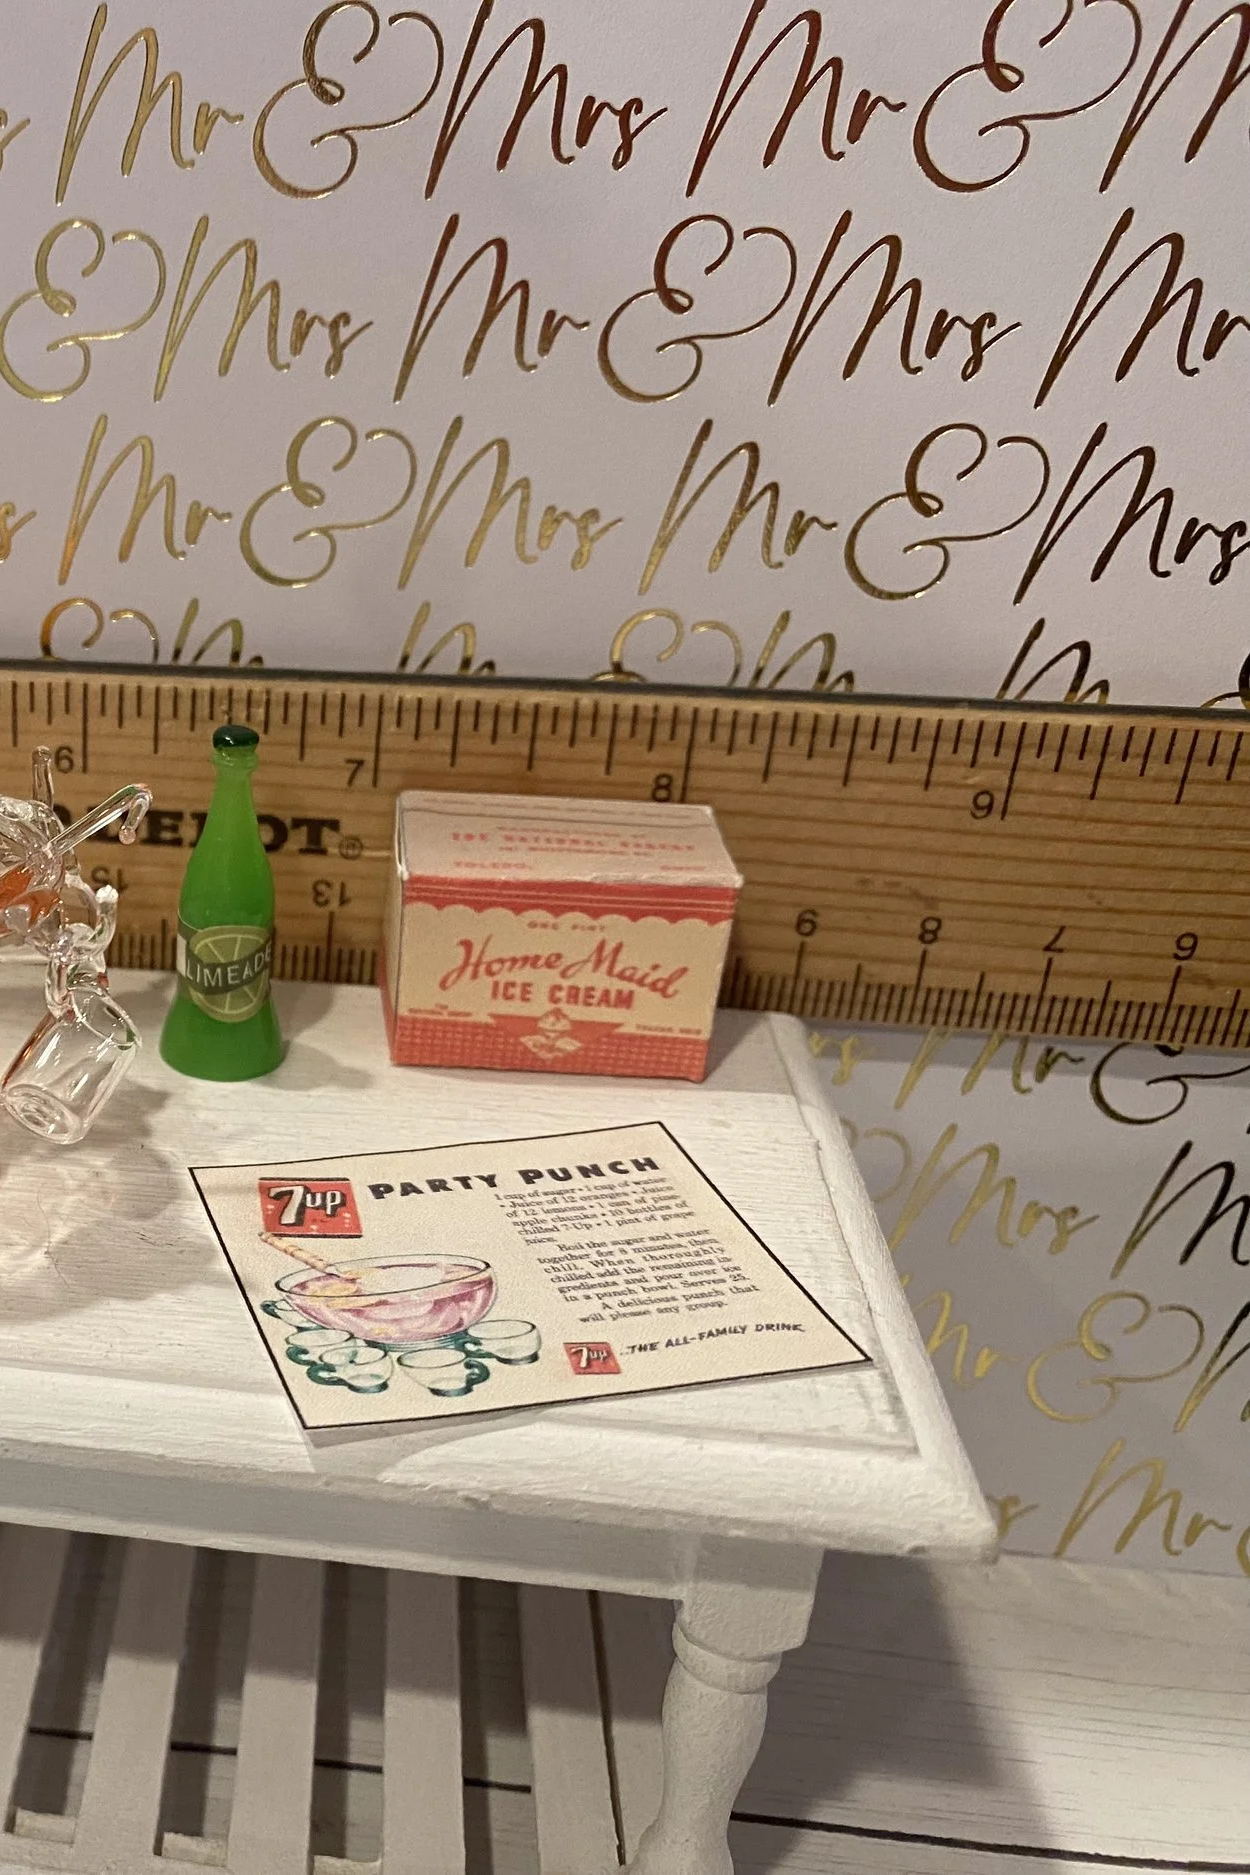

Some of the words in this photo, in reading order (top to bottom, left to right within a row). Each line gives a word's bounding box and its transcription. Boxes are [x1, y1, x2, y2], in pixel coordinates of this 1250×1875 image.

[56, 3, 243, 205] Mr
[253, 0, 443, 200] &
[426, 0, 667, 199] Mrs
[688, 0, 906, 197] Mr
[915, 0, 1142, 192] &
[155, 214, 373, 403] Mrs
[394, 213, 590, 403] Mr
[598, 214, 797, 402] &
[768, 209, 1022, 407] Mrs
[1034, 207, 1250, 409] Mr
[59, 415, 231, 586] Mr
[240, 416, 417, 588] &
[397, 416, 623, 590] Mrs
[638, 419, 837, 595] Mr
[845, 423, 1050, 600] &
[1013, 422, 1250, 605] Mrs
[55, 746, 75, 774] 6
[345, 759, 365, 787] 7
[652, 773, 673, 804] 8
[970, 790, 995, 820] 9
[312, 880, 347, 908] 13
[918, 916, 942, 944] 8
[185, 941, 273, 987] LIMEADE
[439, 934, 563, 992] Home
[559, 938, 689, 999] Maid
[490, 980, 535, 1002] ICE
[547, 984, 636, 1010] CREAM
[367, 1173, 498, 1200] PARTY
[517, 1157, 660, 1186] PUNCH
[888, 1123, 1100, 1256] Mrs
[528, 1190, 540, 1198] of
[546, 1197, 559, 1205] of
[579, 1192, 629, 1201] oranges
[506, 1210, 519, 1218] of
[522, 1208, 538, 1216] 12
[512, 1218, 548, 1227] apple
[551, 1213, 598, 1222] chunks
[625, 1205, 672, 1214] bottles
[675, 1200, 688, 1208] of
[518, 1225, 560, 1235] chilled
[616, 1217, 642, 1226] pint
[661, 1211, 695, 1221] grape
[585, 1241, 608, 1249] the
[648, 1232, 672, 1241] and
[537, 1253, 591, 1264] together
[596, 1250, 615, 1258] for
[543, 1263, 584, 1274] chill.
[588, 1258, 635, 1268] When
[642, 1246, 726, 1261] thoroughly
[550, 1272, 595, 1283] chilled
[596, 1267, 621, 1278] add
[623, 1267, 645, 1275] the
[649, 1258, 715, 1271] remaining
[558, 1281, 619, 1294] gredients
[624, 1275, 649, 1284] and
[654, 1272, 684, 1282] pour
[689, 1268, 718, 1277] over
[563, 1294, 580, 1302] in
[596, 1287, 638, 1301] punch
[641, 1282, 679, 1293] bowl.
[680, 1279, 727, 1288] Serves
[602, 1301, 613, 1310] A
[617, 1296, 679, 1308] delicious
[682, 1288, 725, 1301] punch
[729, 1284, 760, 1294] that
[579, 1313, 606, 1323] will
[609, 1308, 651, 1321] please
[656, 1304, 680, 1314] any
[686, 1300, 728, 1312] group.
[665, 1324, 748, 1350] ALL-FAMILY
[755, 1322, 806, 1333] DRINK
[1026, 1291, 1205, 1423] &
[1055, 1437, 1232, 1557] Mr
